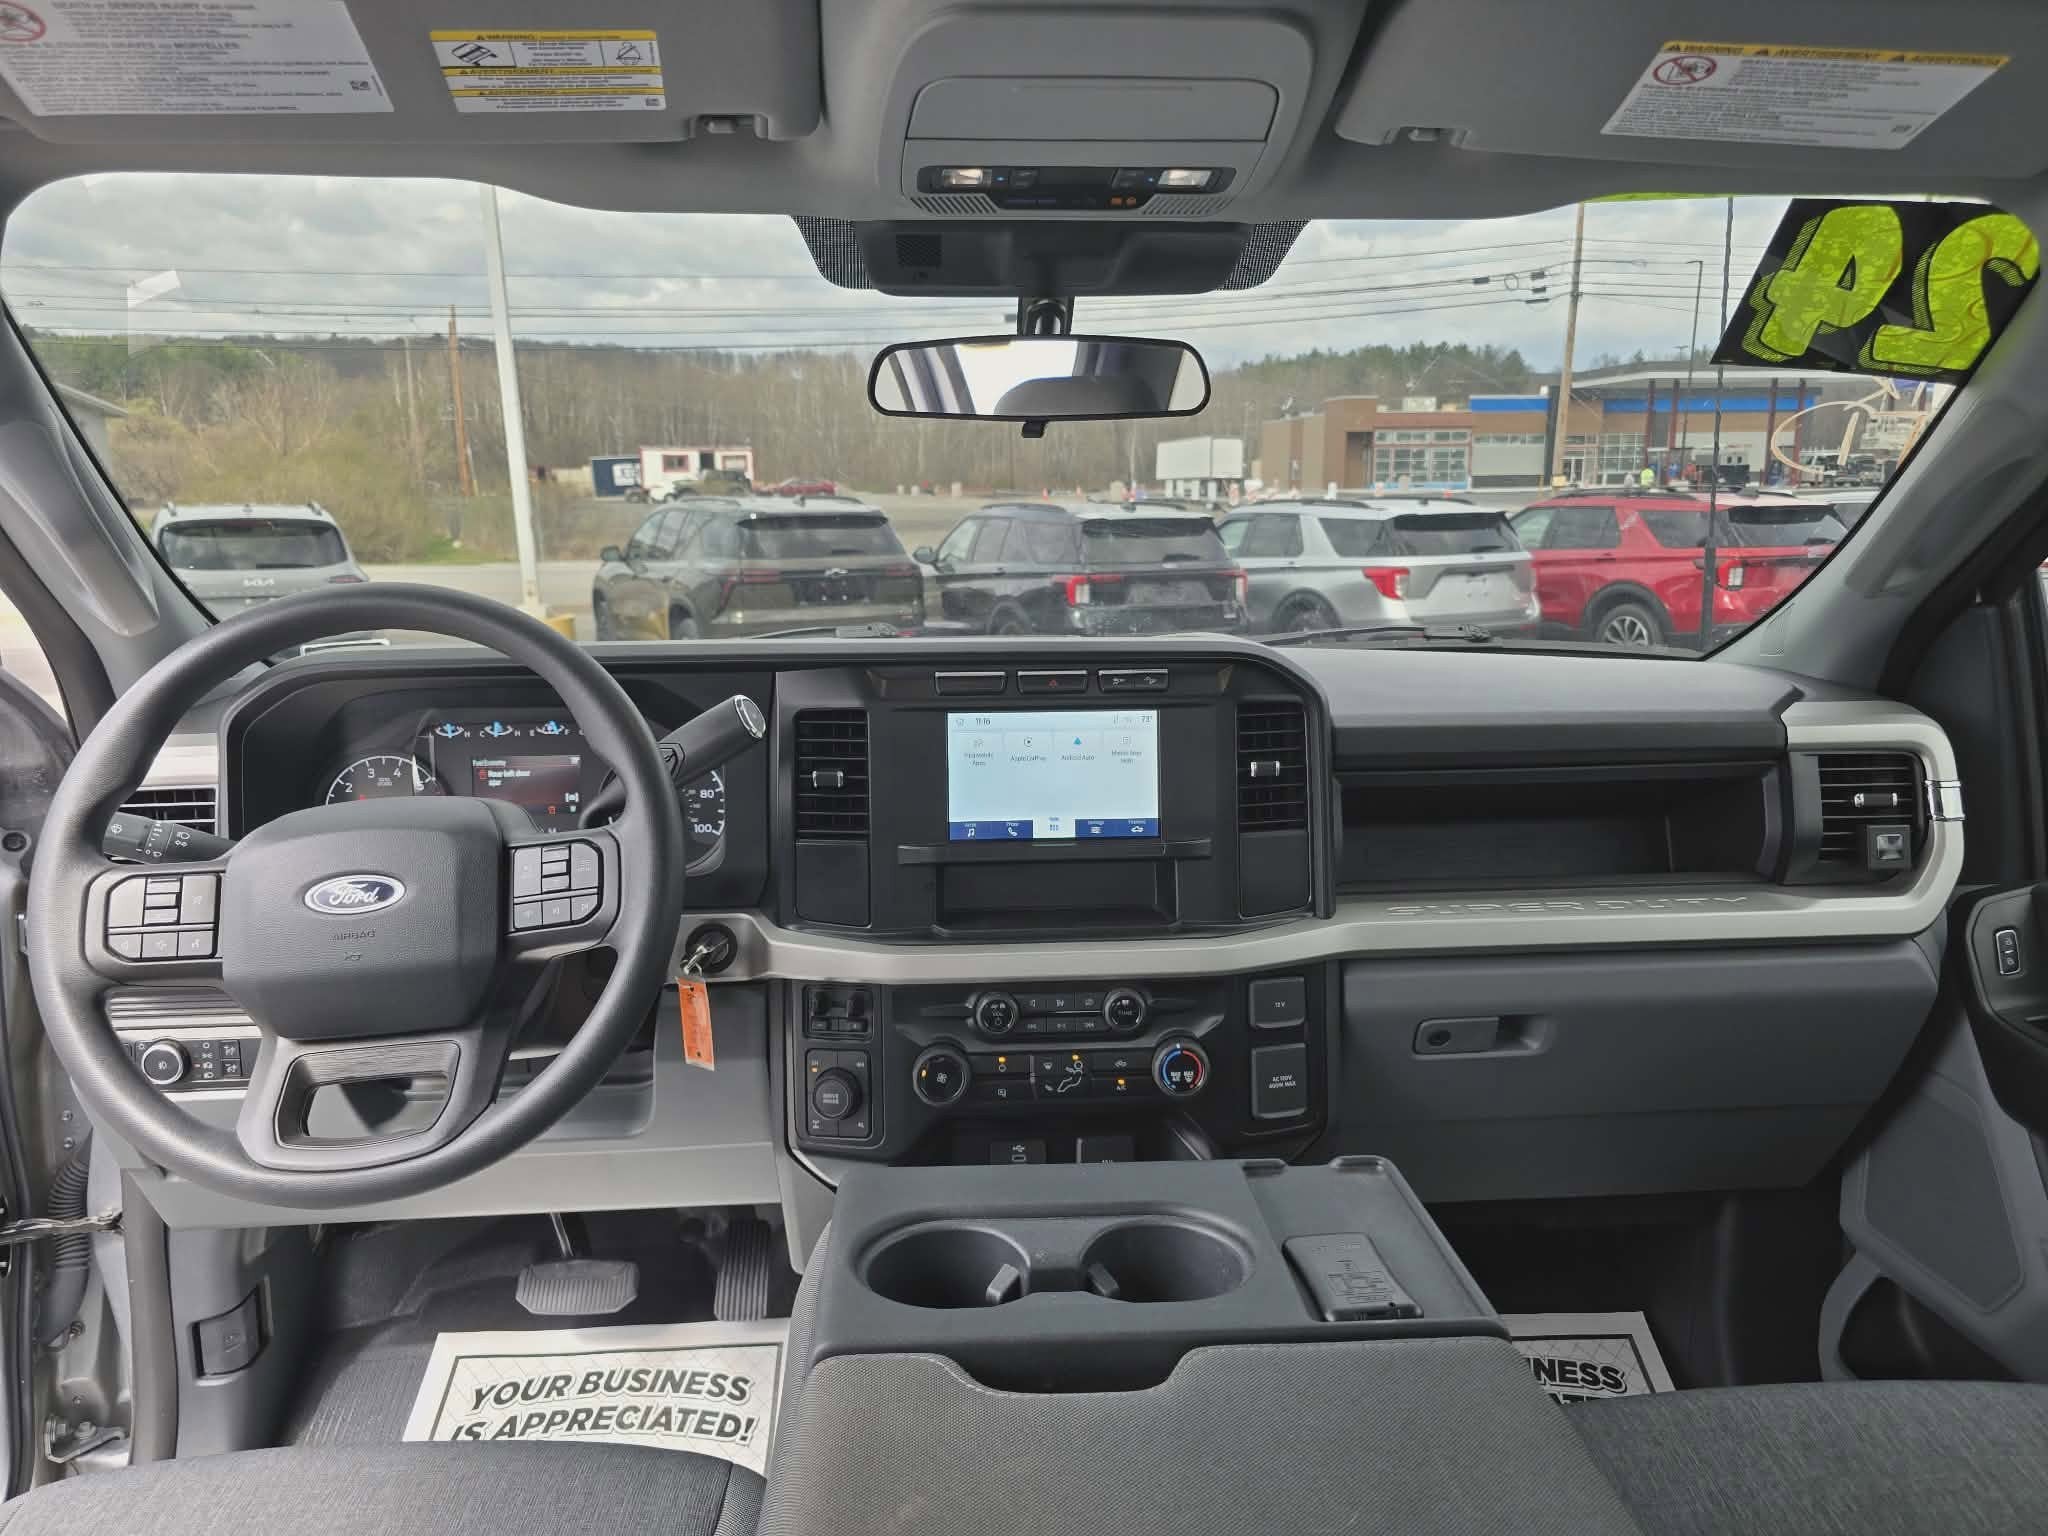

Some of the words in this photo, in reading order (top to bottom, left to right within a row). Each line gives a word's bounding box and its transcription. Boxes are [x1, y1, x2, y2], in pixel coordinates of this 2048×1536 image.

[367, 768, 375, 778] 3
[393, 767, 402, 778] 4
[345, 782, 353, 793] 2
[415, 781, 425, 791] 5
[700, 789, 715, 798] 80
[694, 823, 713, 833] 100
[1386, 901, 1585, 915] SUPER
[1526, 1357, 1625, 1392] NESS
[471, 1374, 573, 1411] YOUR
[577, 1368, 751, 1402] BUSINESS
[450, 1420, 488, 1441] IS
[493, 1406, 756, 1443] APPRECIATED!
